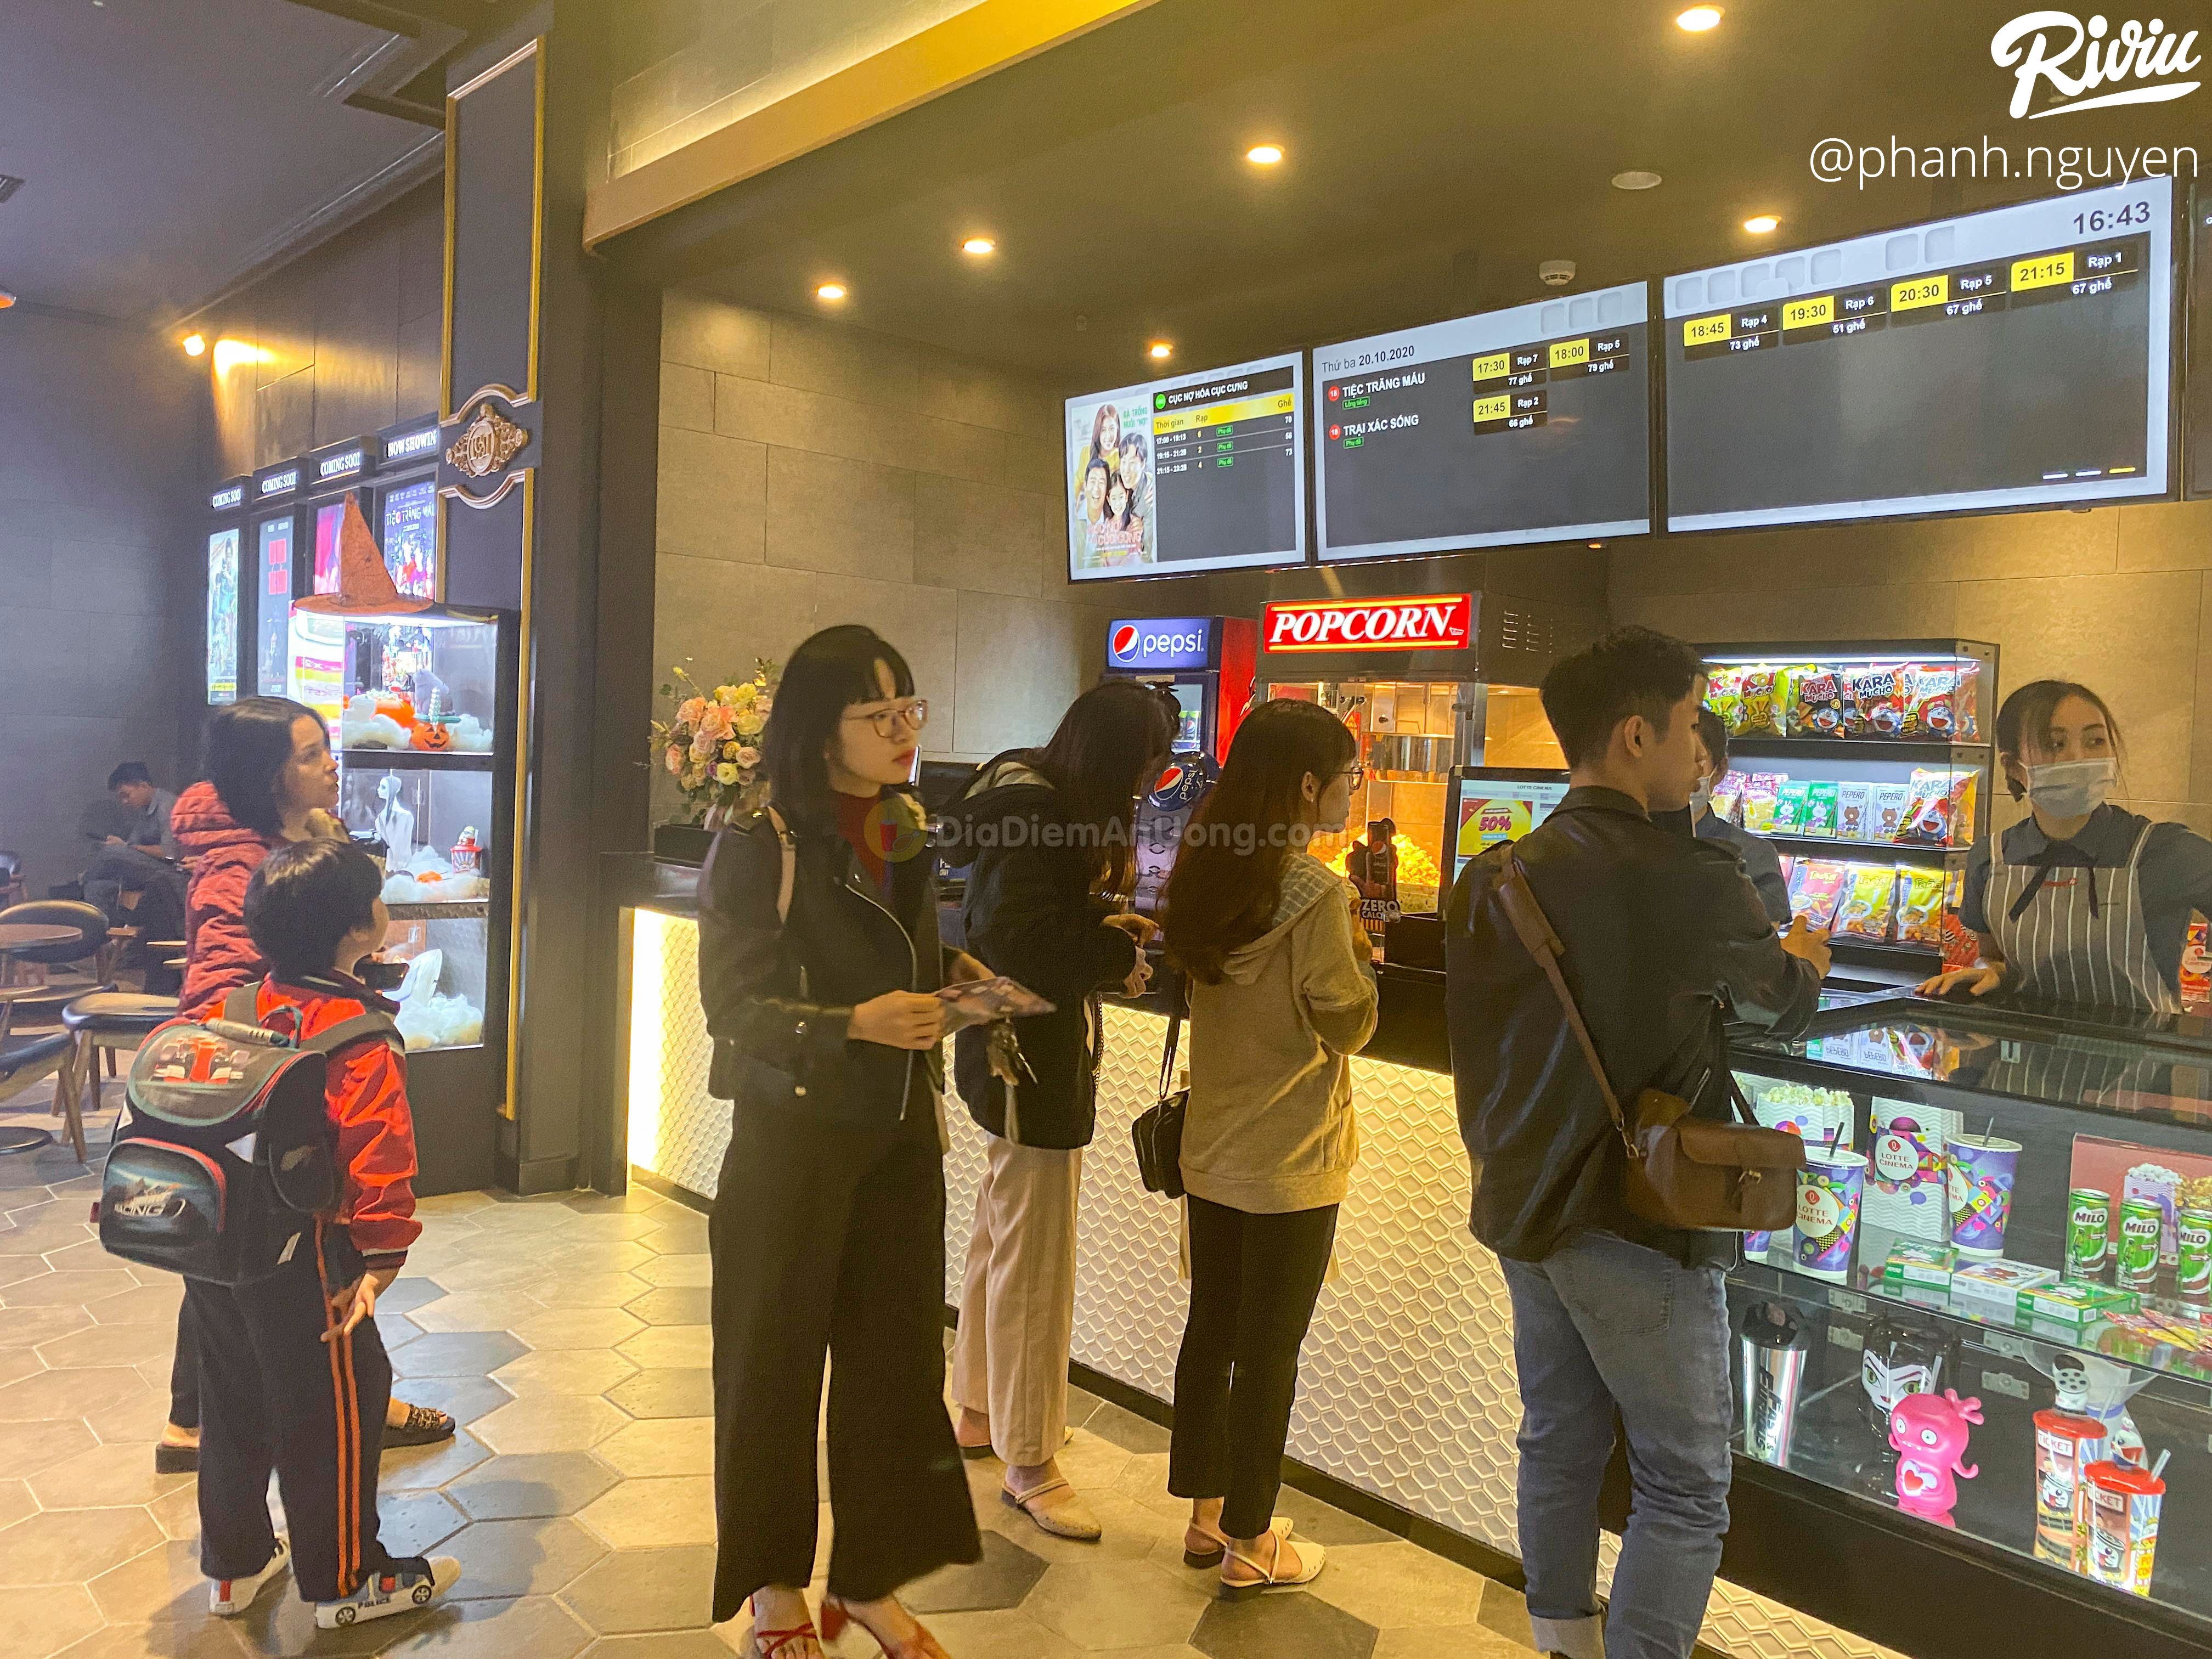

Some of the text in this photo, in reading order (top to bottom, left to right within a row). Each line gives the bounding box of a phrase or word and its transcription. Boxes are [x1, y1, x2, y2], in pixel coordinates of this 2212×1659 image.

[2073, 201, 2151, 235] 16:43
[2020, 252, 2122, 282] 21:15 Rạp 1
[1898, 275, 1993, 302] 20:30 Rạp 5
[2072, 276, 2113, 297] 67 ghế
[1790, 296, 1874, 321] 19:30 Rạp 6
[1945, 298, 1983, 317] 67 ghế
[1691, 314, 1768, 338] 18:45 Rạp 4
[1832, 318, 1865, 334] 51 ghế
[1555, 340, 1621, 360] 18:00 Rạp 5
[1729, 336, 1760, 351] 73 ghế
[1322, 346, 1414, 373] Thứ ba 20.10.2020
[1478, 354, 1538, 373] 17:30 Rạp 7
[1588, 364, 1598, 373] 79
[1342, 383, 1364, 398] TIỆC
[1366, 377, 1400, 393] TRĂNG
[1402, 371, 1425, 387] MÁU
[1509, 376, 1517, 386] 77
[1169, 394, 1182, 405] CỤC
[1195, 387, 1210, 399] HÓA
[1211, 386, 1227, 398] CỤC
[1156, 397, 1291, 430] Thời gian Rạp Ghế
[1479, 397, 1539, 415] 21:45 Rạp 2
[1285, 416, 1293, 424] 70
[1344, 423, 1365, 437] TRẠI
[1367, 418, 1388, 433] XÁC
[1509, 419, 1518, 427] 66
[387, 430, 437, 458] NOW SHOWIN
[320, 456, 345, 476] COMING
[262, 477, 283, 494] COMING
[212, 488, 241, 508] COMING SOO
[1269, 605, 1458, 644] POPCORN
[1143, 629, 1204, 658] pepsi
[1800, 680, 1837, 696] KARA
[1853, 672, 1896, 692] KARA
[1917, 674, 1961, 687] KARA
[1804, 692, 1835, 703] MUCHO
[1859, 685, 1893, 699] MUCHO
[1920, 685, 1955, 695] MUCHO
[1180, 769, 1198, 800] pepsi
[1910, 778, 1954, 792] KARA
[1842, 790, 1865, 799] PEPERO
[1879, 792, 1903, 801] PEPERO
[1914, 788, 1949, 799] MUCHO
[1479, 815, 1511, 831] 50%
[1362, 899, 1398, 913] ZERO
[1879, 1159, 1914, 1170] CINEMA
[1881, 1153, 1910, 1163] LOTTE
[1797, 1204, 1829, 1217] LOTTE
[2075, 1212, 2105, 1223] MILO
[2125, 1222, 2156, 1234] MILO
[2039, 1432, 2072, 1453] TICKET
